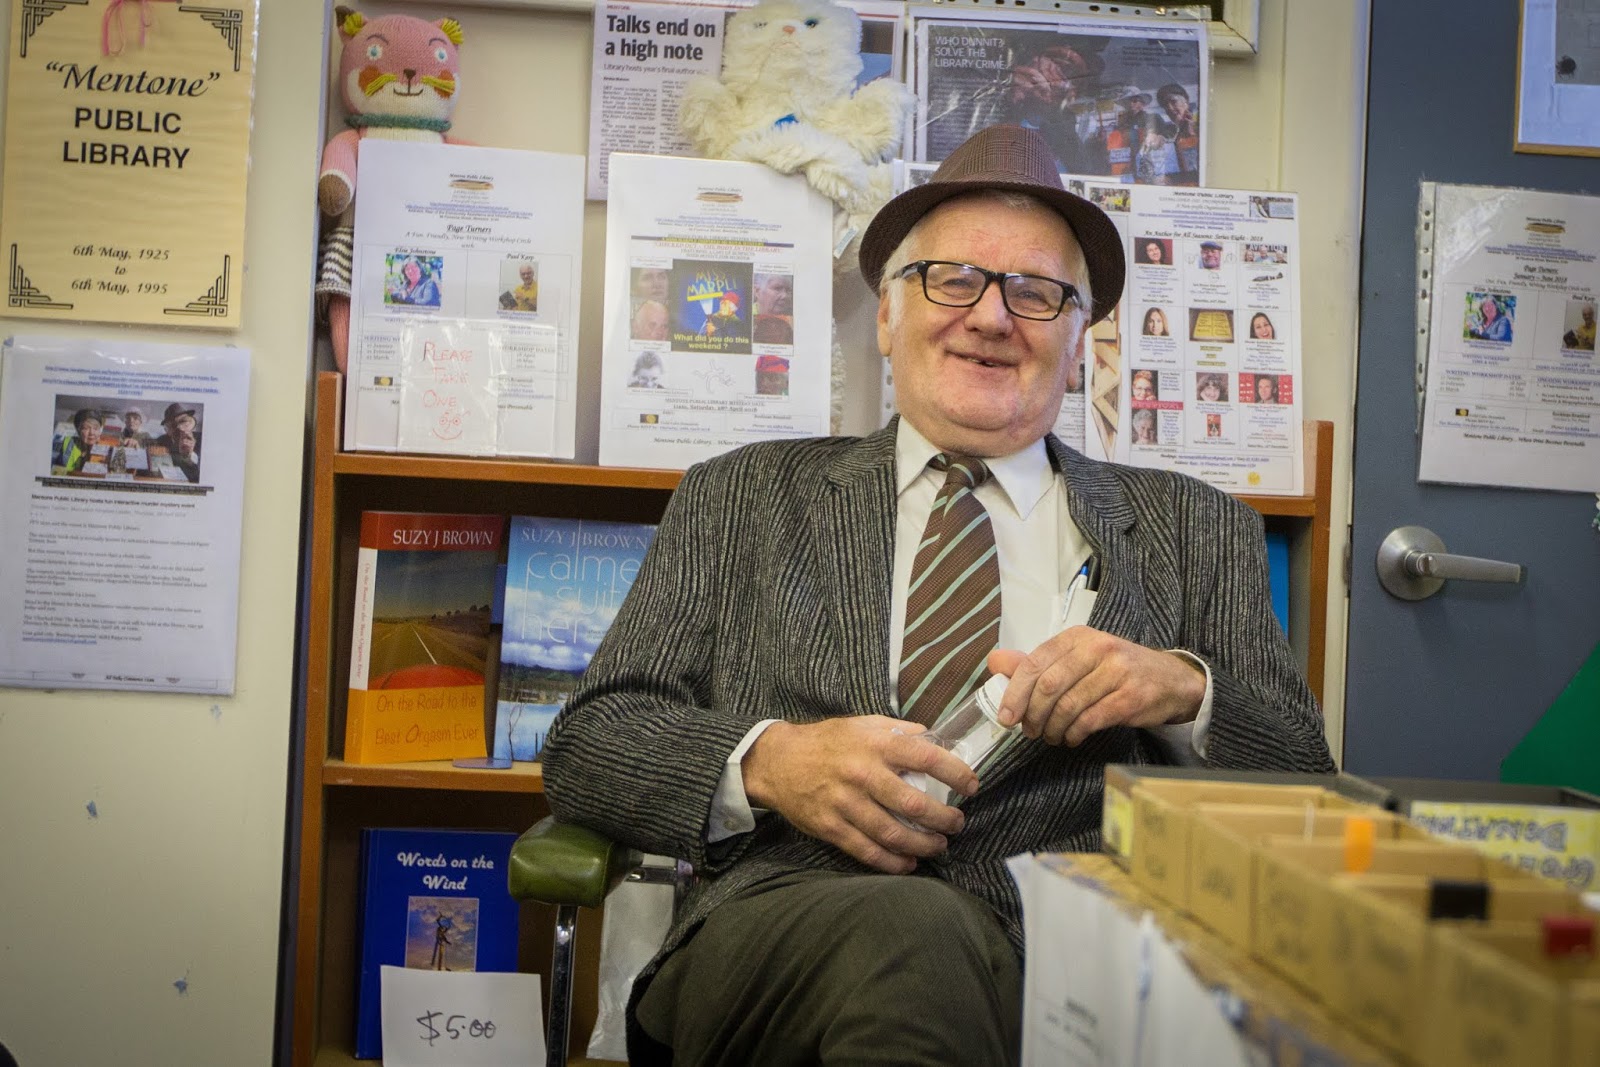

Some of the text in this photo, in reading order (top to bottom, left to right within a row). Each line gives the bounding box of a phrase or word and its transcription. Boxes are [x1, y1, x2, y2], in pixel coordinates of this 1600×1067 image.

[606, 14, 716, 37] Talks end on
[605, 38, 703, 61] a high note
[935, 36, 1005, 48] WHO DUNNIT?
[934, 47, 986, 58] SOLVE THE
[935, 58, 1005, 70] LIBRARY CRIME
[45, 61, 220, 97] “Mentone”
[74, 107, 181, 134] PUBLIC
[63, 141, 190, 169] LIBRARY
[446, 224, 463, 234] Page
[73, 245, 170, 261] 6th May, 1925
[115, 264, 126, 275] to
[71, 279, 169, 295] 6th May, 1995
[673, 333, 749, 344] What did you do this
[688, 342, 729, 351] weekend ?
[423, 389, 458, 410] ONE
[393, 528, 494, 549] SUZY J BROWN
[521, 526, 562, 544] SUZY
[583, 533, 649, 551] BROWN
[377, 692, 477, 712] On the Road to the
[375, 723, 480, 747] Best Orgasm Ever
[397, 851, 495, 869] Words on the
[422, 874, 469, 891] Wind
[416, 1009, 497, 1048] $5.00
